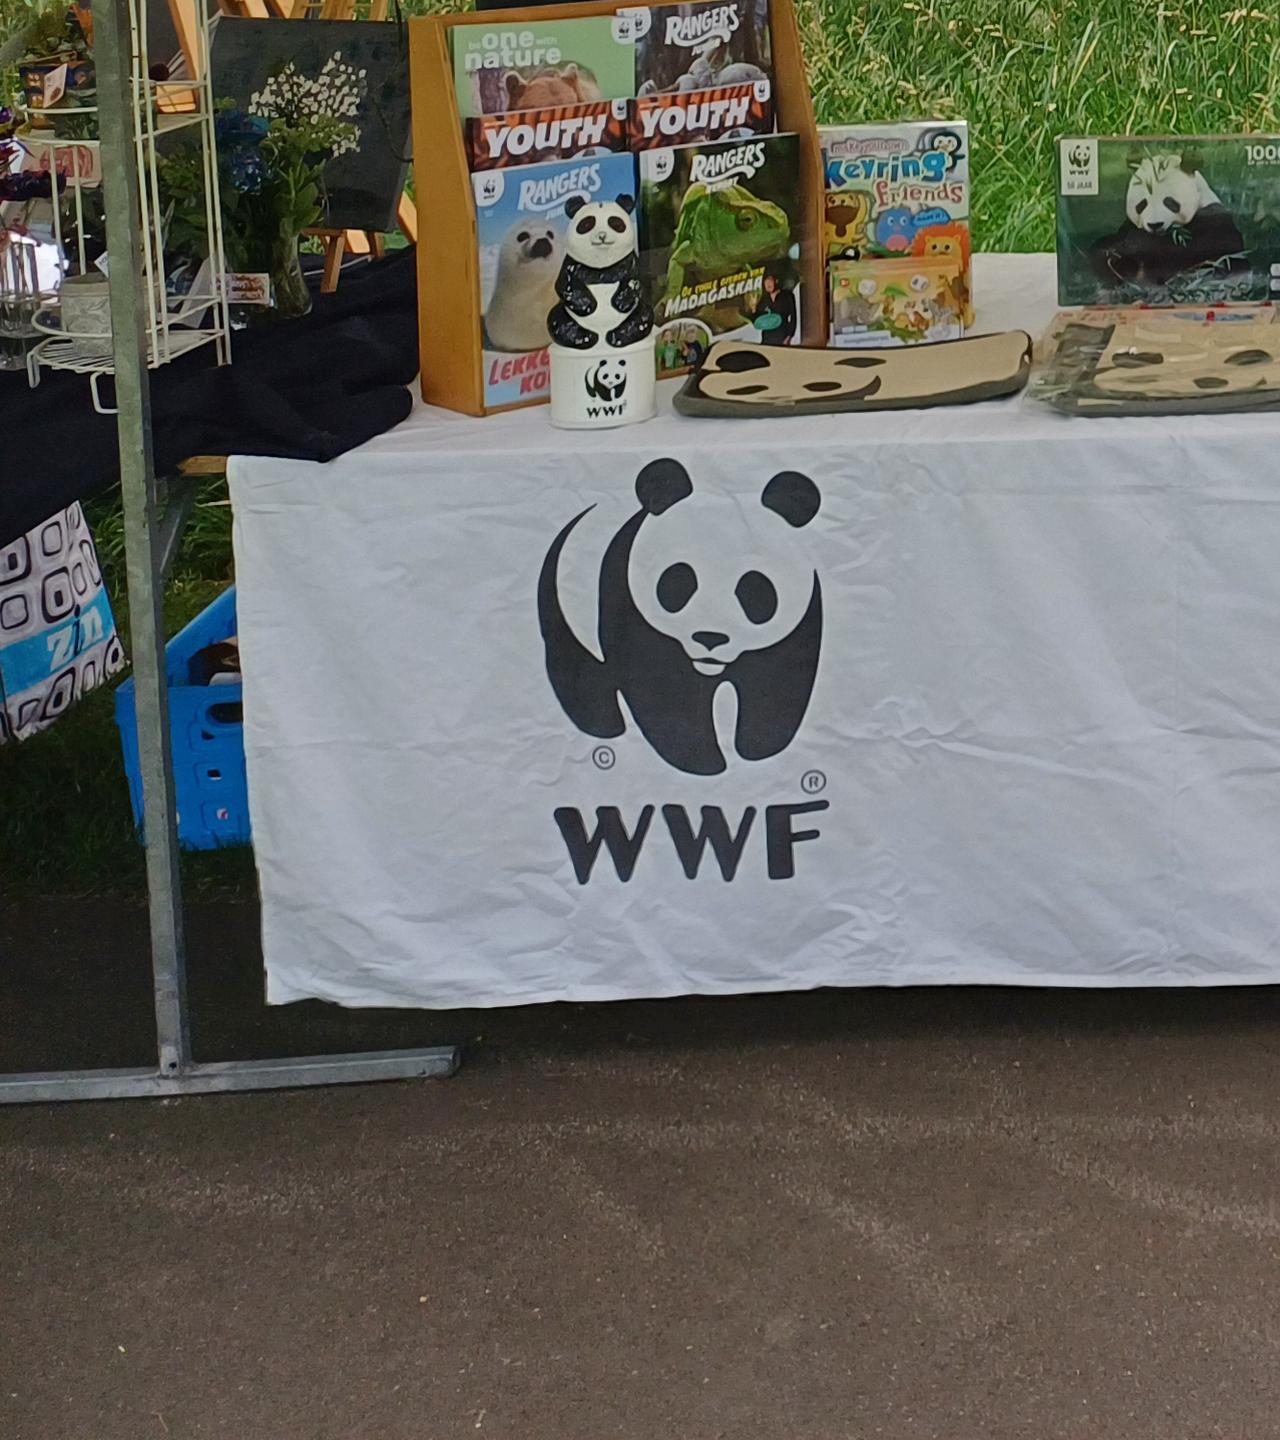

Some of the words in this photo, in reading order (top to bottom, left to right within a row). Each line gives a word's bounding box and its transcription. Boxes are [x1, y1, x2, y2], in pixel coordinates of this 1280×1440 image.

[482, 31, 534, 49] one
[664, 4, 740, 47] RANGERS
[465, 47, 561, 70] nature
[484, 113, 608, 159] YOUTH
[639, 96, 750, 138] YOUTH
[690, 142, 766, 184] RANGERS
[518, 163, 601, 211] RANGERS
[876, 180, 963, 207] friends
[664, 274, 764, 318] MADAGASKAR
[47, 604, 103, 672] zin
[554, 800, 830, 885] WWF
